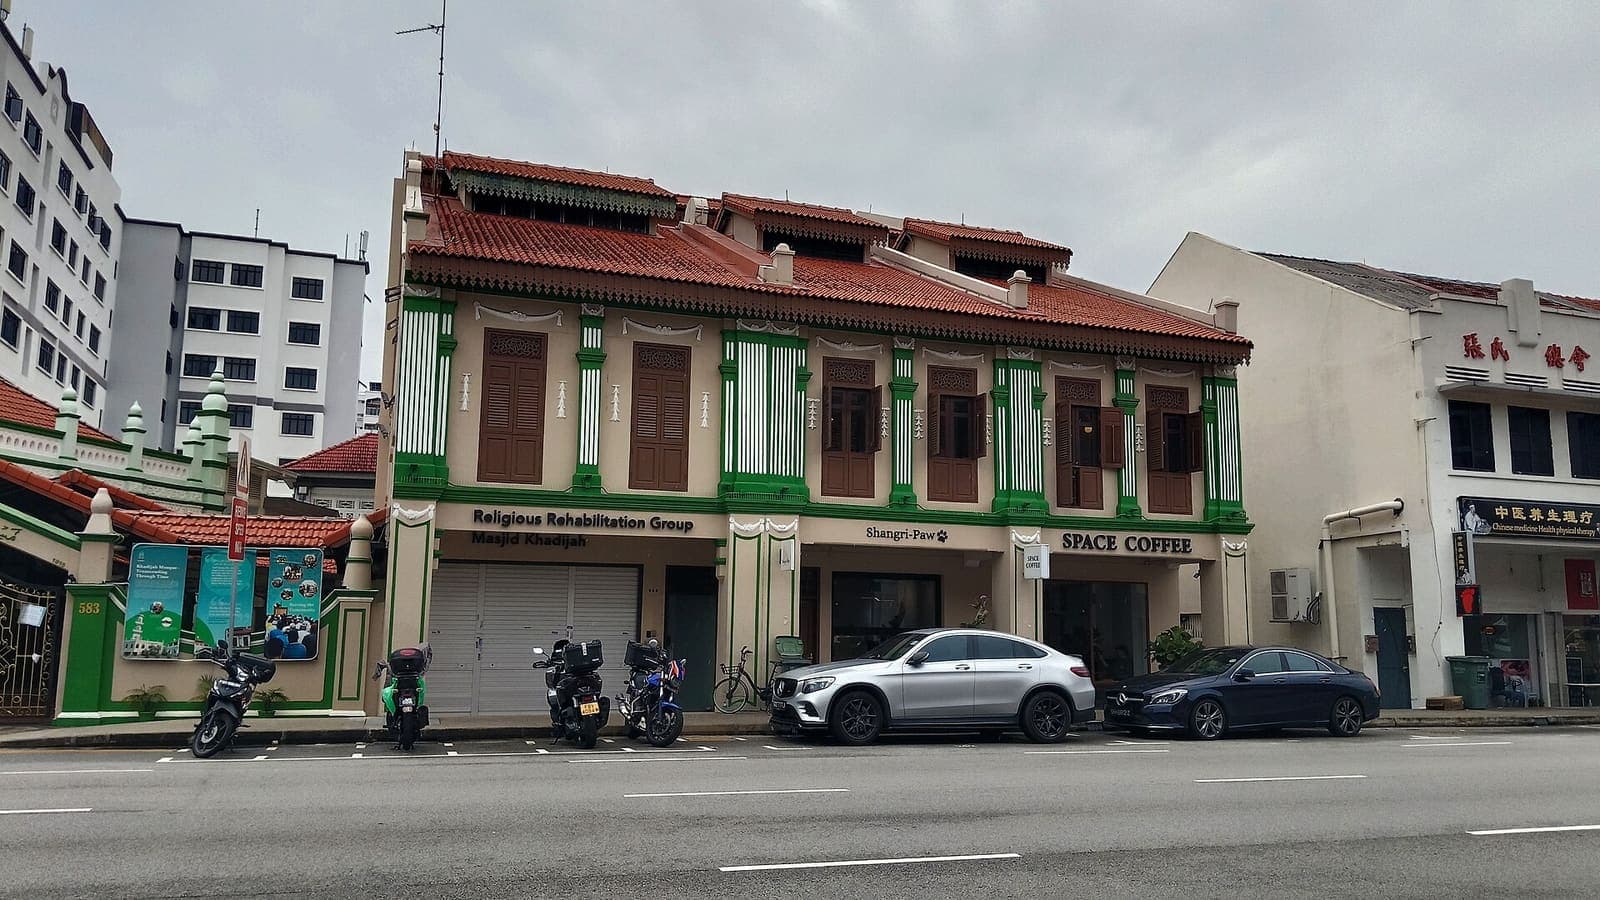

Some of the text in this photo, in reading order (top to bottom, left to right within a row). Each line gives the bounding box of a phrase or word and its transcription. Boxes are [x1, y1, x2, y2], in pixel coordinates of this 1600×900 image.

[473, 510, 694, 533] Religious Rehabilitation Group
[1495, 506, 1593, 524] 中医养生理疗
[866, 527, 935, 541] Shangri-Paw
[1492, 522, 1596, 536] Chinese medicine Health physical therapy
[472, 532, 586, 549] Masjid Khadijah
[1062, 533, 1193, 553] SPACE COFFEE
[79, 602, 100, 614] 583
